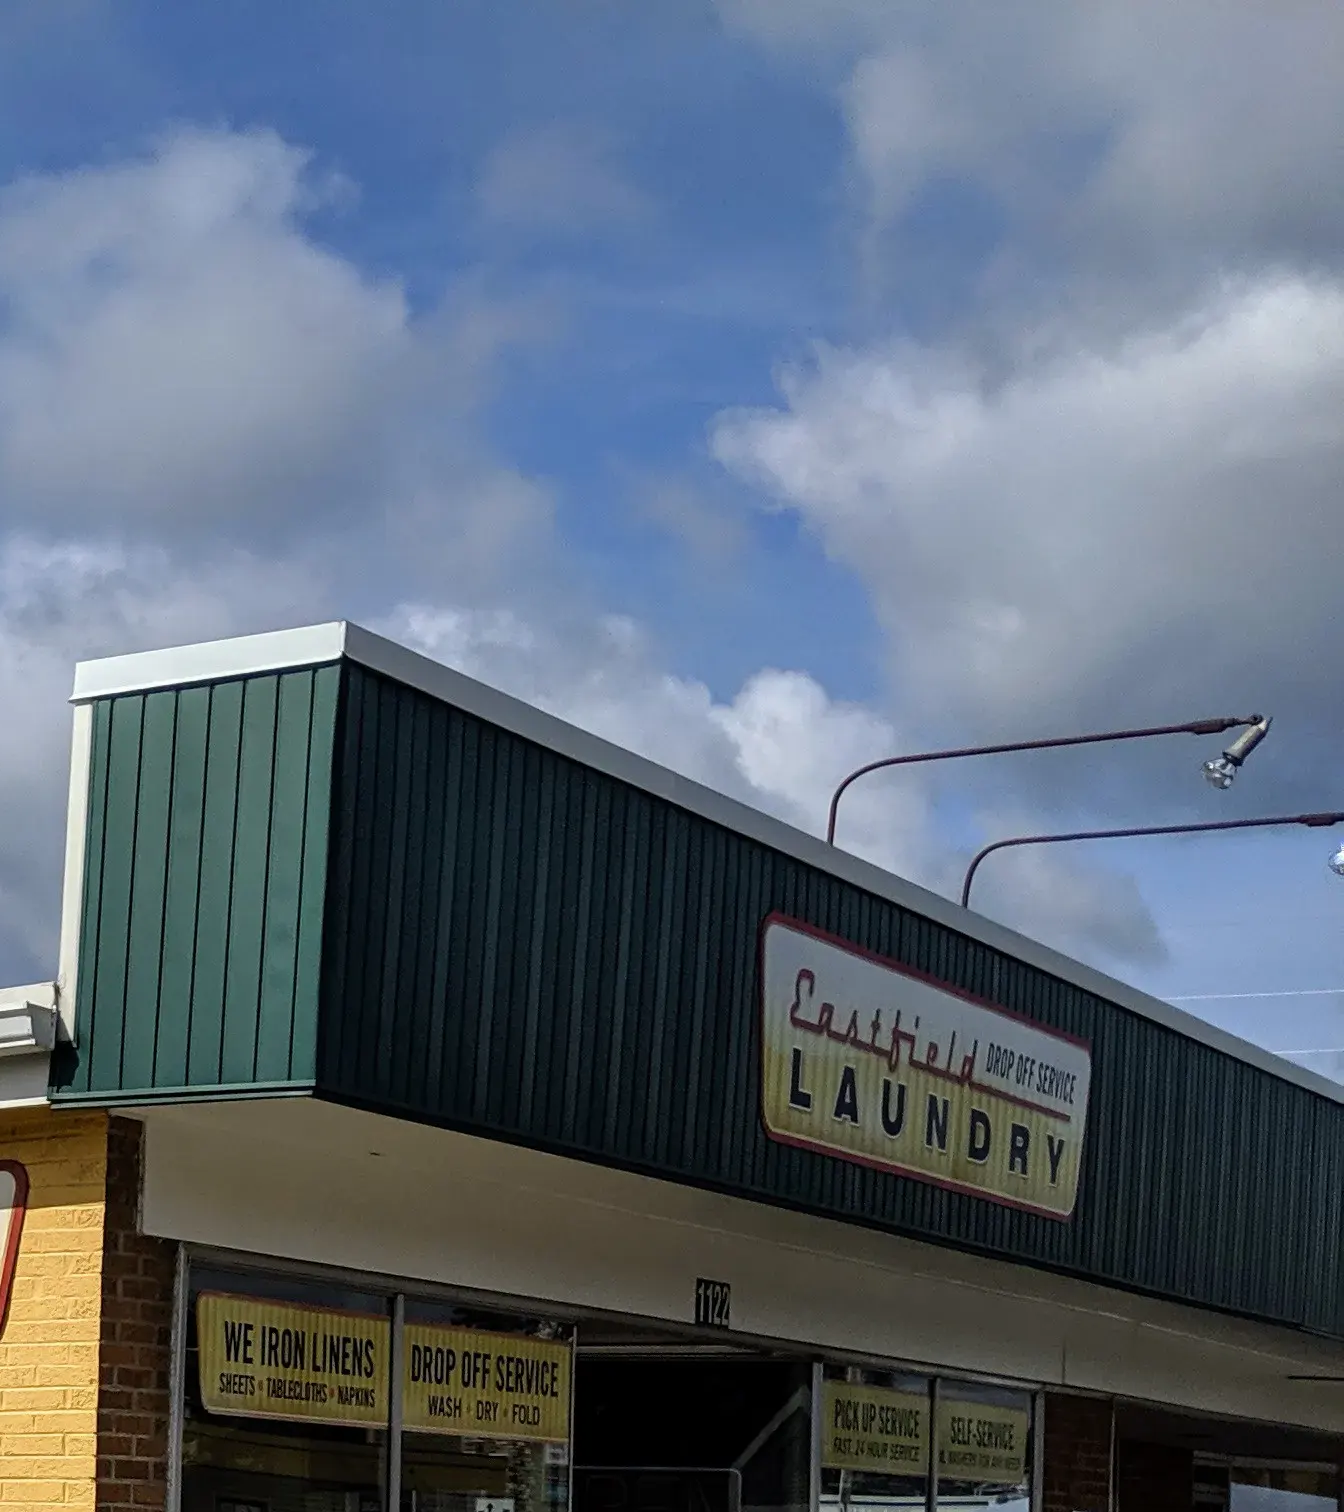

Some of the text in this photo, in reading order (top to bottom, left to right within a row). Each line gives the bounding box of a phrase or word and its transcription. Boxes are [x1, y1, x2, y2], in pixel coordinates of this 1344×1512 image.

[789, 968, 980, 1086] Eastfield
[984, 1041, 1078, 1105] DROP OFF SERVICE
[788, 1046, 1066, 1188] LAUNDRY
[698, 1281, 730, 1326] 1122
[224, 1320, 375, 1379] WE IRON LINENS
[411, 1344, 559, 1398] DROP OFF SERVICE
[219, 1372, 376, 1408] SHEETS TABLECLOTHS NAPKINS
[428, 1395, 541, 1426] WASH DRY FOLD
[834, 1398, 920, 1439] PICK UP SERVICE
[950, 1415, 1016, 1450] SELF-SERVICE
[890, 1443, 920, 1462] SERVICE
